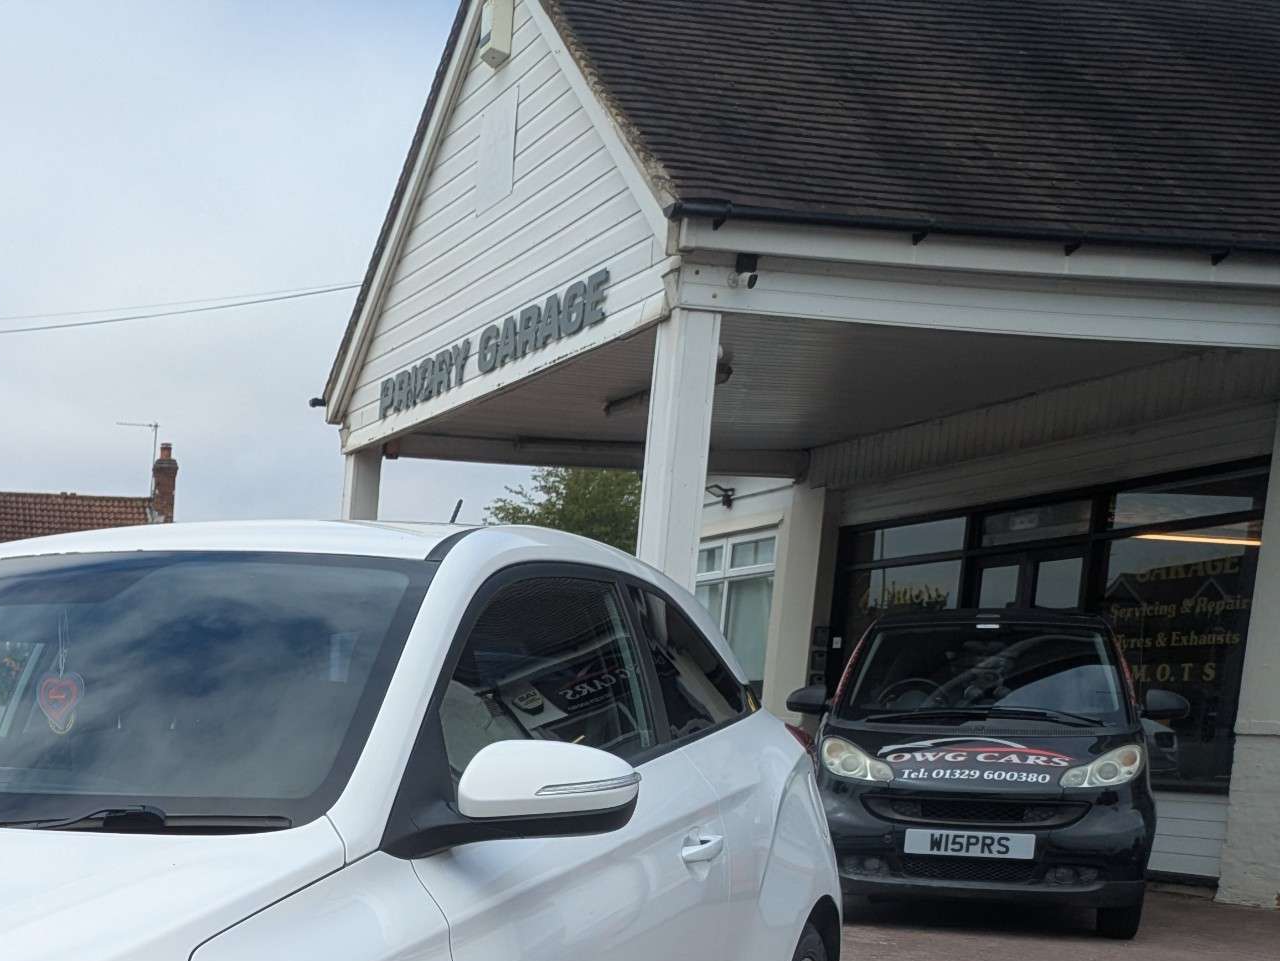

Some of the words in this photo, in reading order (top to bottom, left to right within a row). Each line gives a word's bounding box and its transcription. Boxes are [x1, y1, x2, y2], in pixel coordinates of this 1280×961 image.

[378, 337, 471, 420] PRIORY
[477, 266, 610, 374] GARAGE
[1155, 632, 1167, 648] &
[1170, 631, 1241, 646] Exhausts
[886, 751, 969, 763] OWG
[976, 752, 1071, 767] CARS
[932, 768, 980, 780] 01329
[983, 770, 1050, 784] 600380
